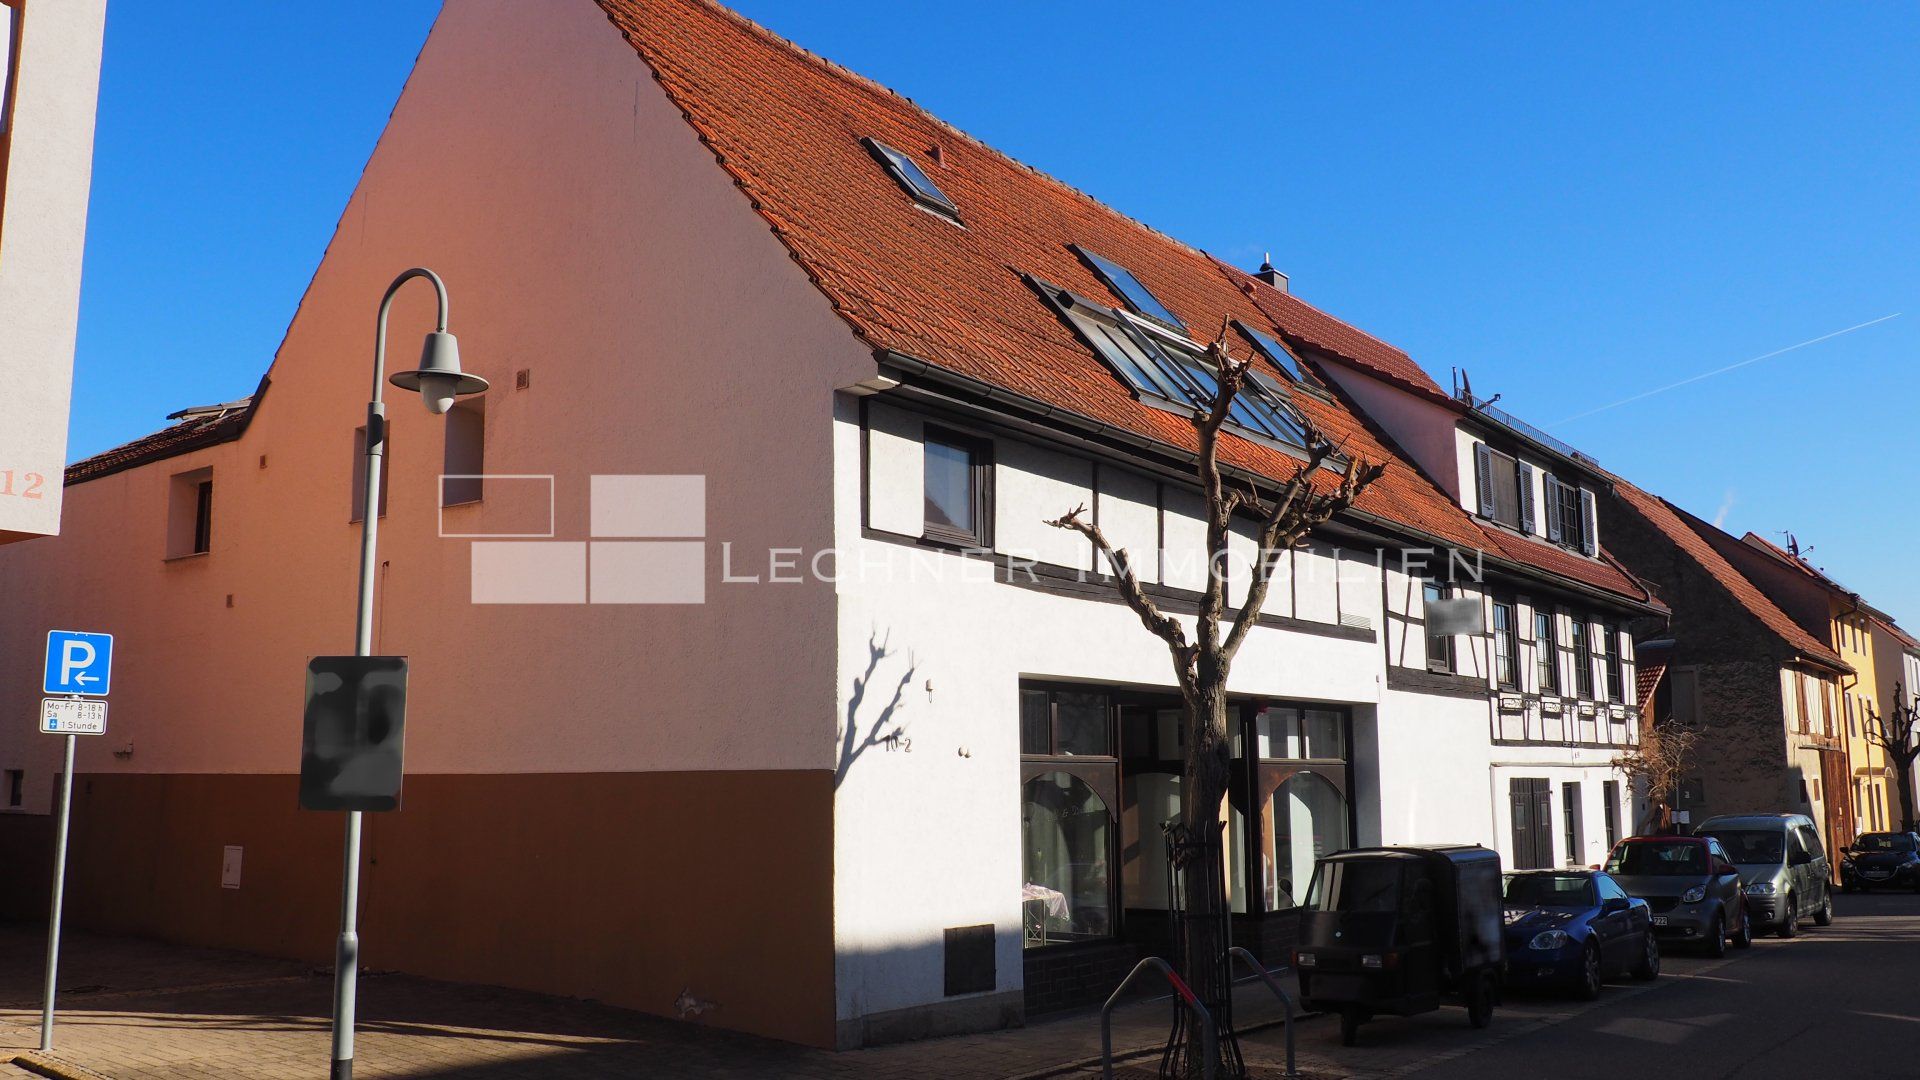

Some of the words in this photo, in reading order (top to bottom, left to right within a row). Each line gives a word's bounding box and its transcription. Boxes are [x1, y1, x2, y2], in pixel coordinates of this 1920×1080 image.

[0, 470, 44, 499] 12
[60, 640, 96, 685] P
[47, 702, 75, 711] Mo-Fr
[78, 703, 97, 712] 8-18
[47, 710, 58, 718] Sa
[77, 711, 96, 720] 8-13
[67, 721, 97, 730] Stunde
